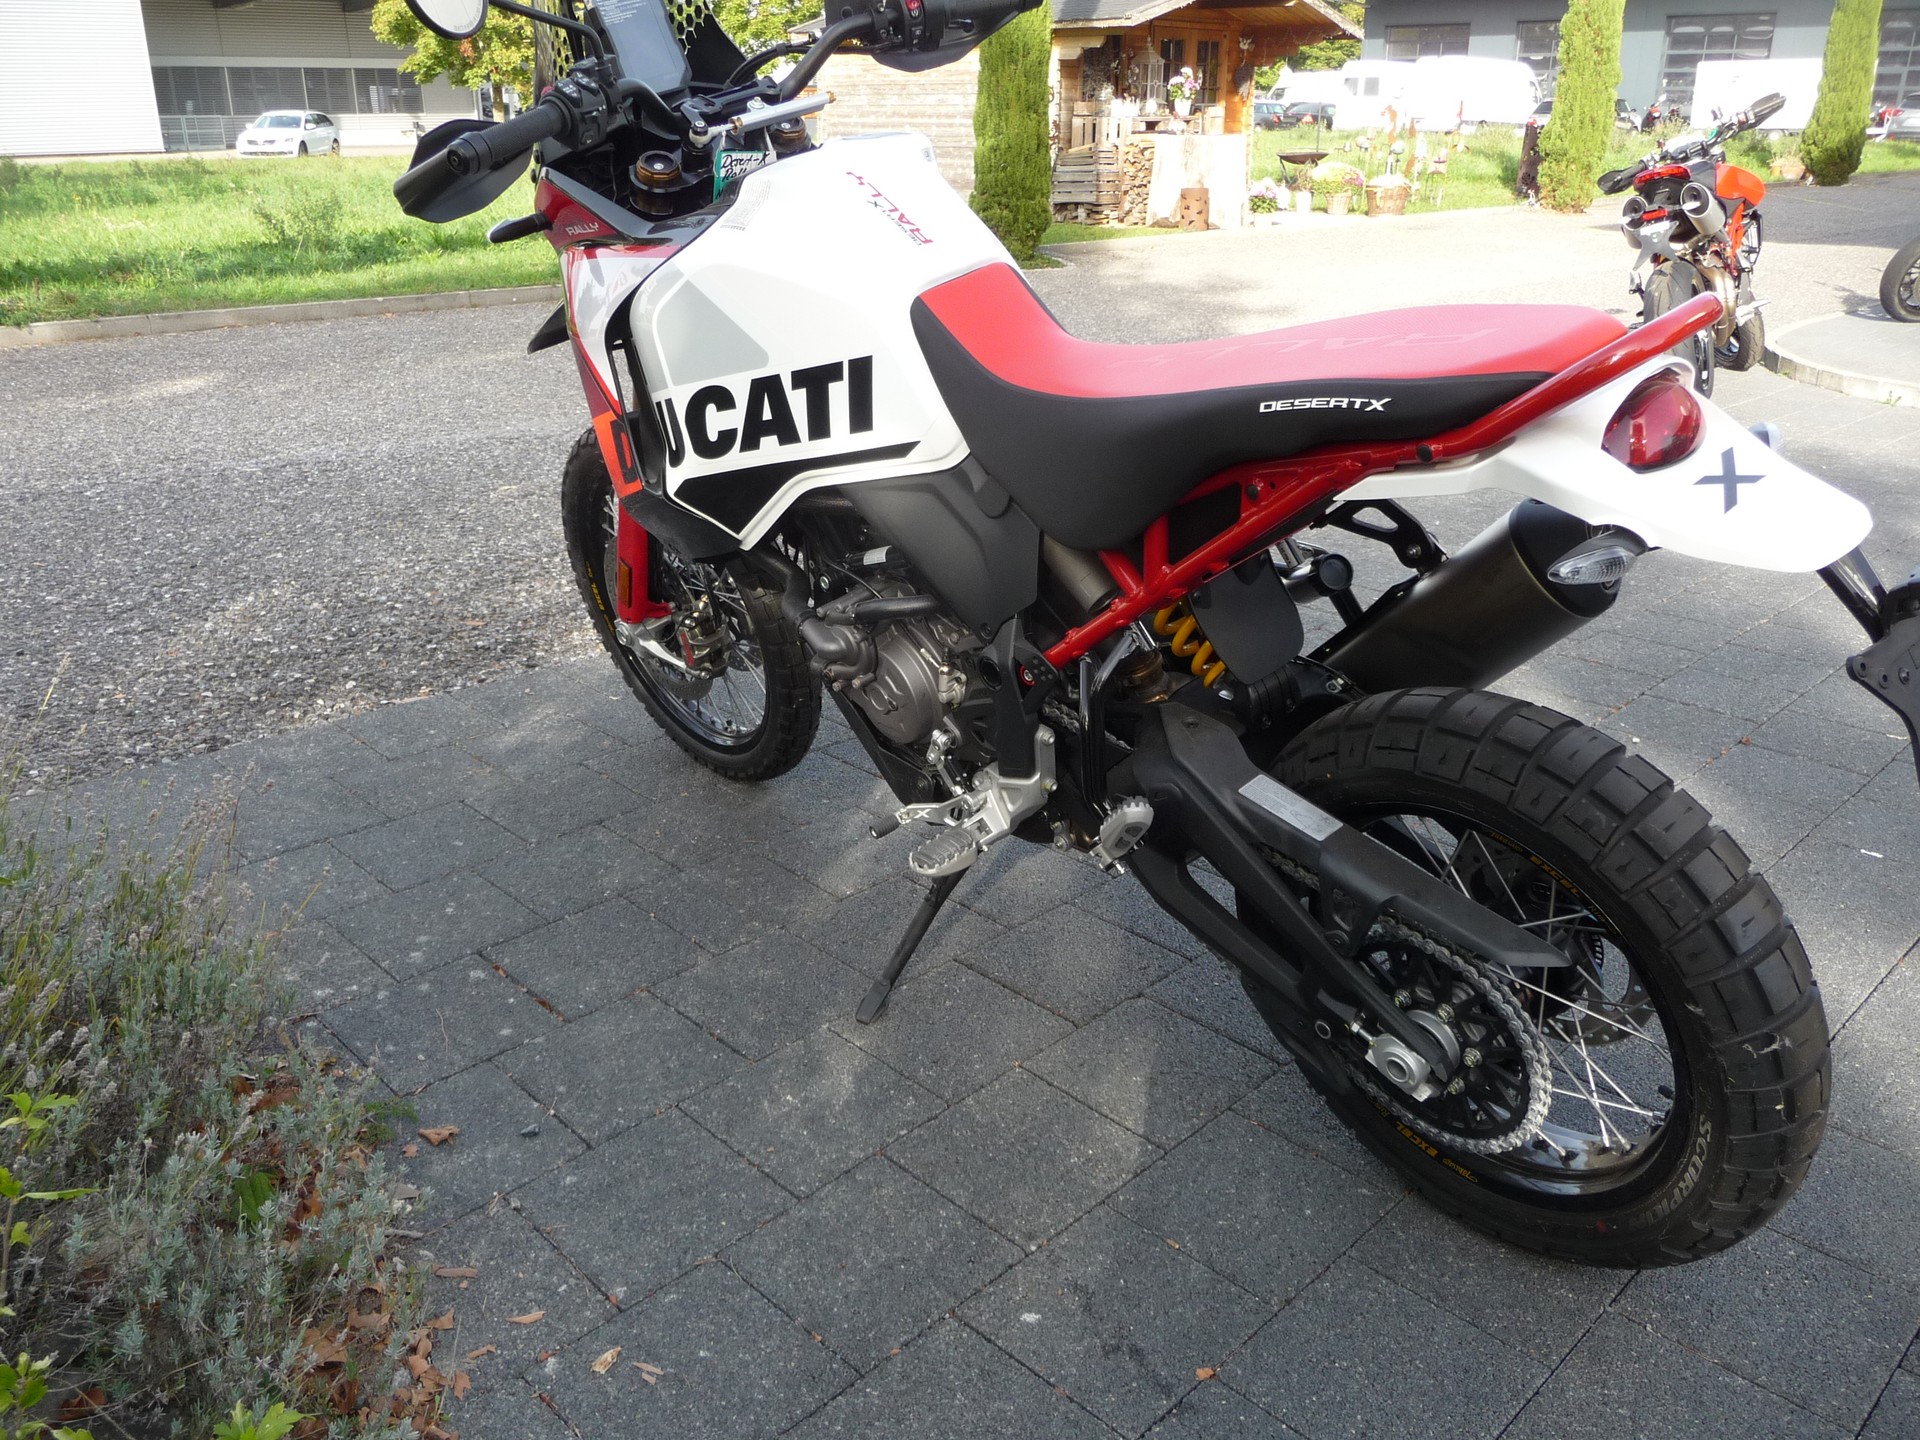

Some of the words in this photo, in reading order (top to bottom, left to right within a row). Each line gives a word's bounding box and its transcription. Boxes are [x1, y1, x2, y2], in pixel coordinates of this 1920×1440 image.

[722, 167, 747, 182] Rall
[846, 171, 934, 244] RALLY
[565, 222, 599, 236] RALLY
[1259, 397, 1392, 414] DESERTX
[1395, 1121, 1439, 1158] EXCEL
